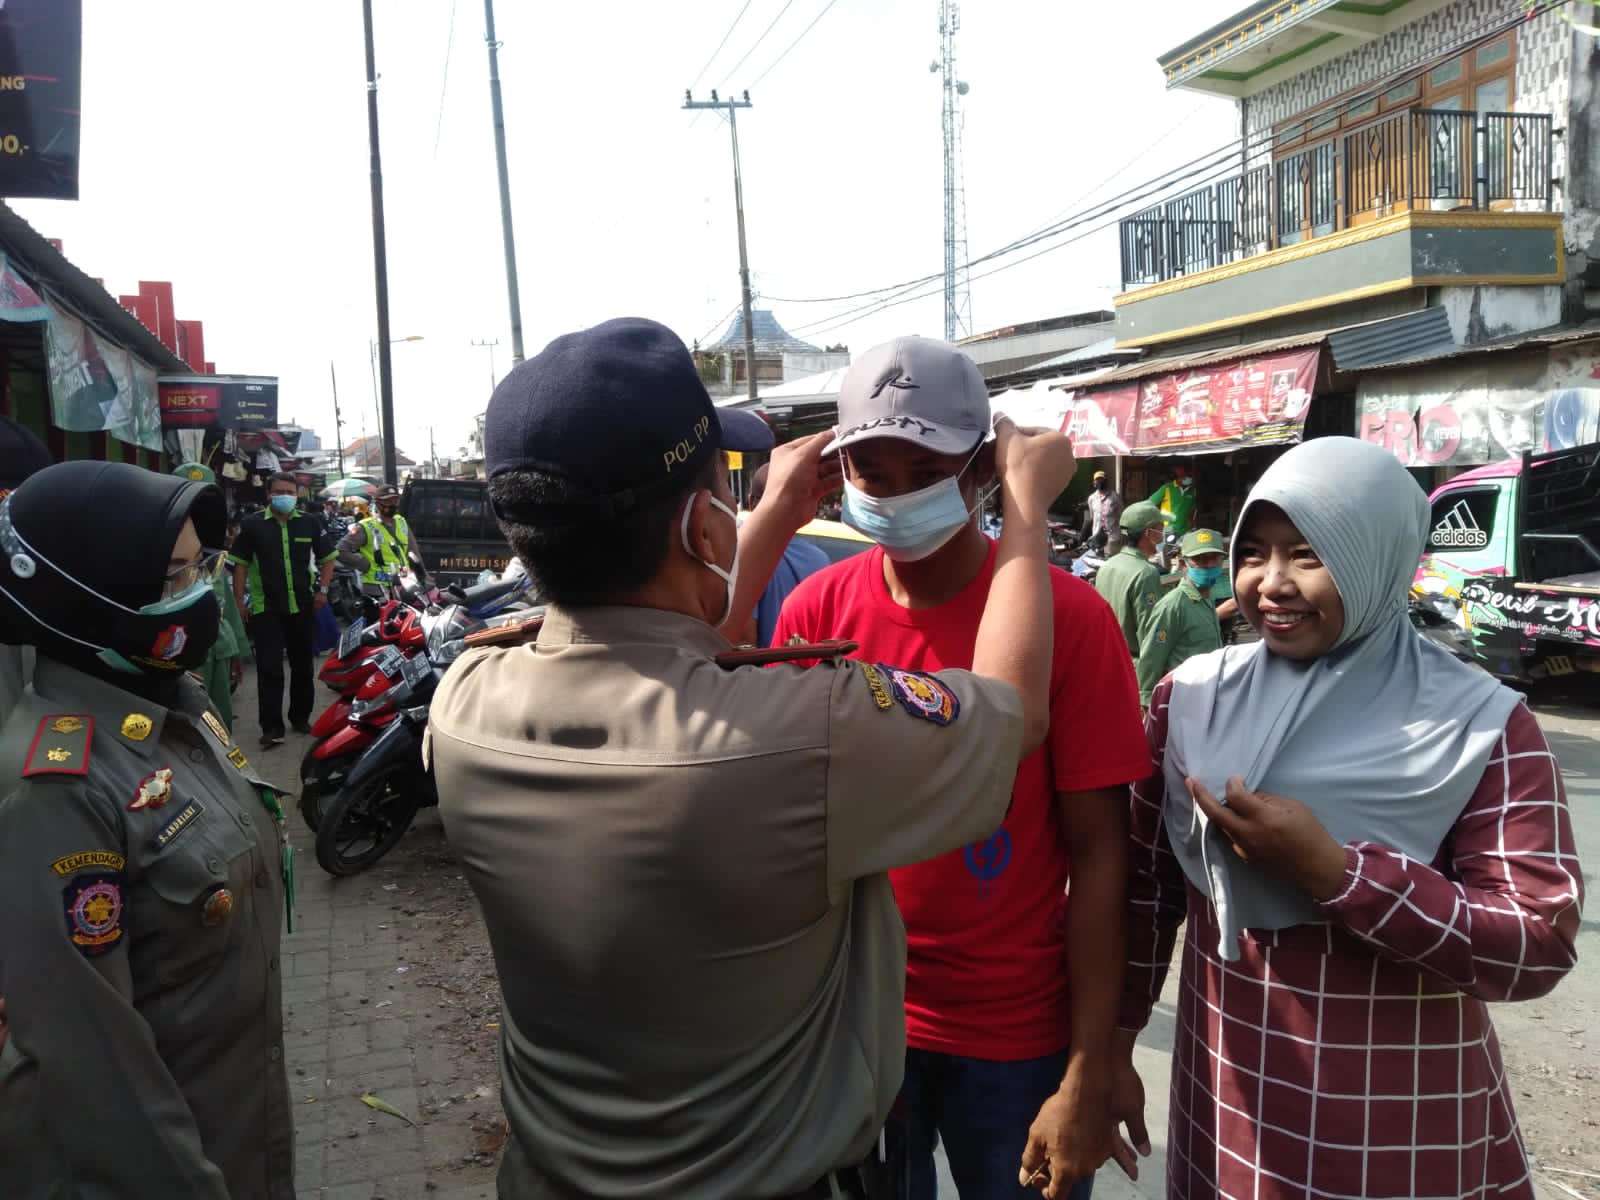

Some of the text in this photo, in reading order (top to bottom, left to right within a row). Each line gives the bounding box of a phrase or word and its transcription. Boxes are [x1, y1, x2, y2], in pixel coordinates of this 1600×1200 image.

[0, 76, 25, 90] NG
[167, 395, 208, 406] NEXT
[664, 415, 709, 472] POL PP
[1431, 529, 1487, 546] adidas
[440, 558, 509, 568] MITSUBISH
[59, 853, 123, 873] KEMENDAGRI
